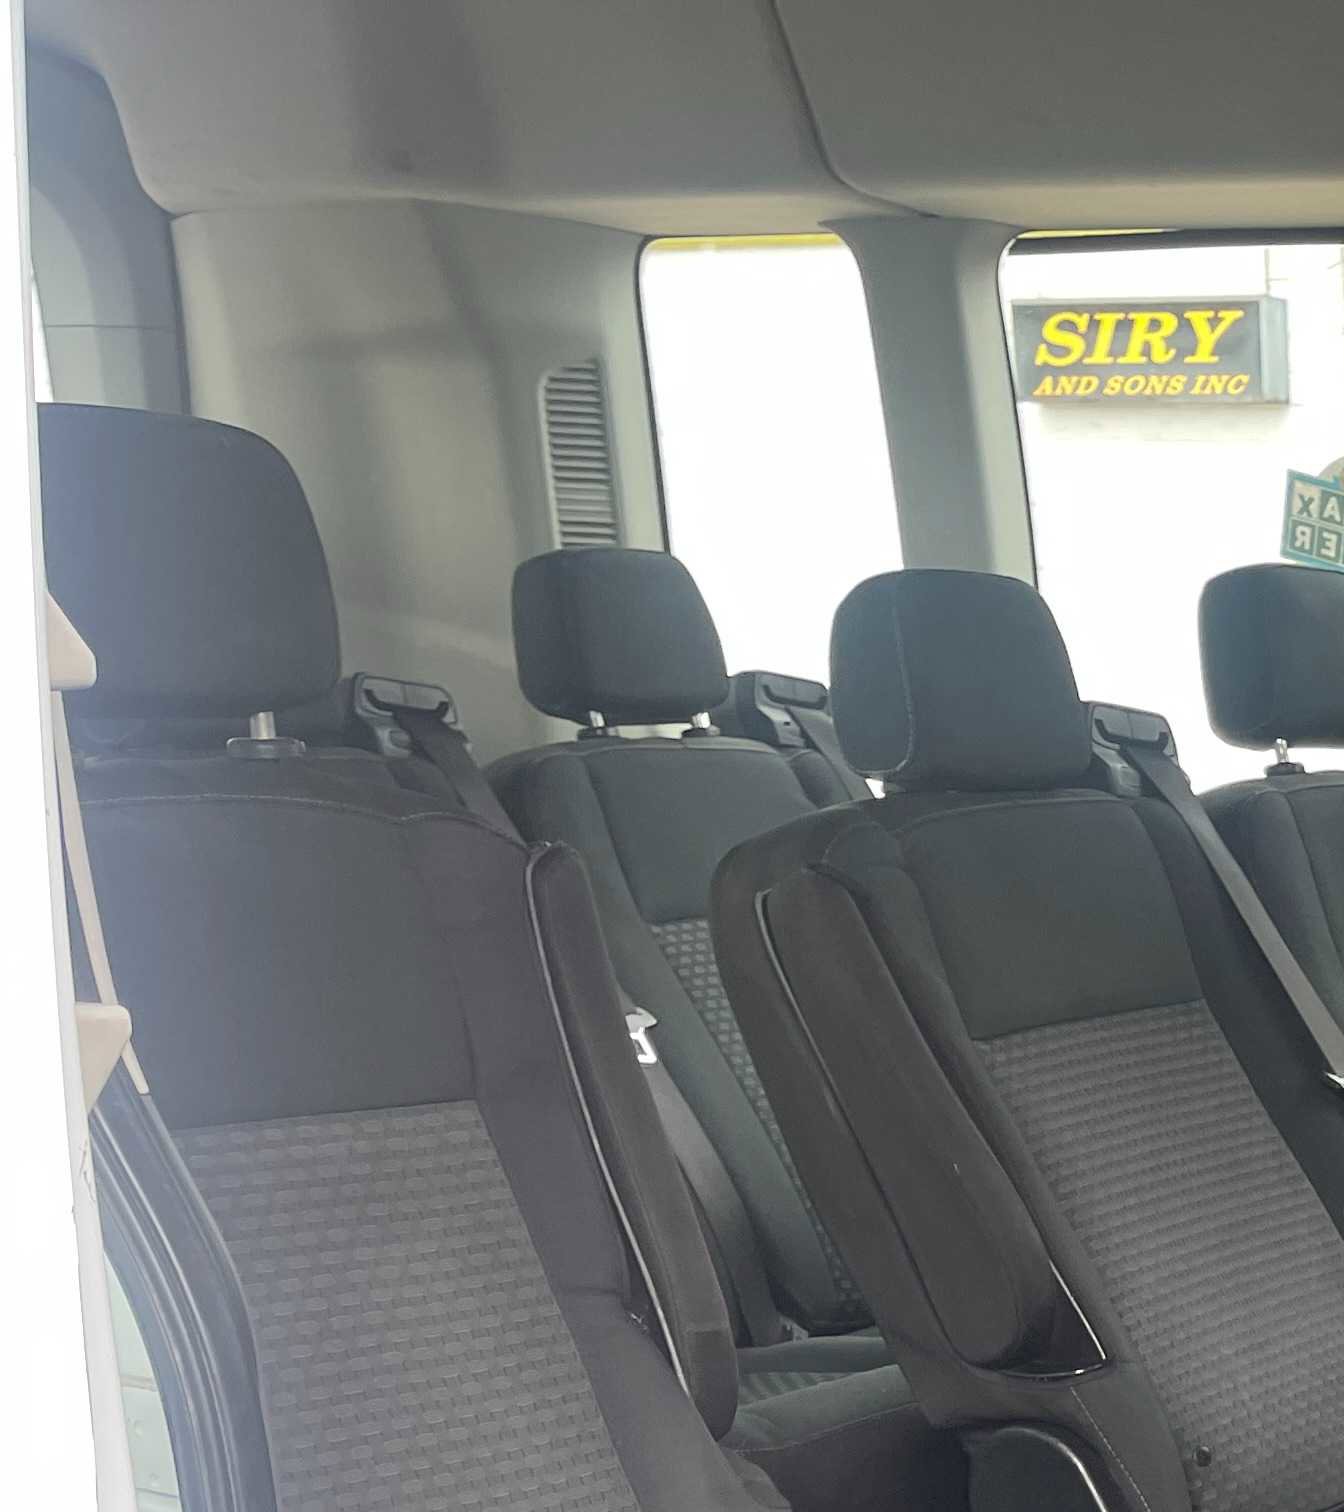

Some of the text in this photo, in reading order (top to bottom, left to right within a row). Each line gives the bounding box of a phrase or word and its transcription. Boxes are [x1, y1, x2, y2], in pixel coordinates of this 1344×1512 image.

[1034, 309, 1245, 367] SIRY
[1032, 373, 1250, 397] AND SONS INC
